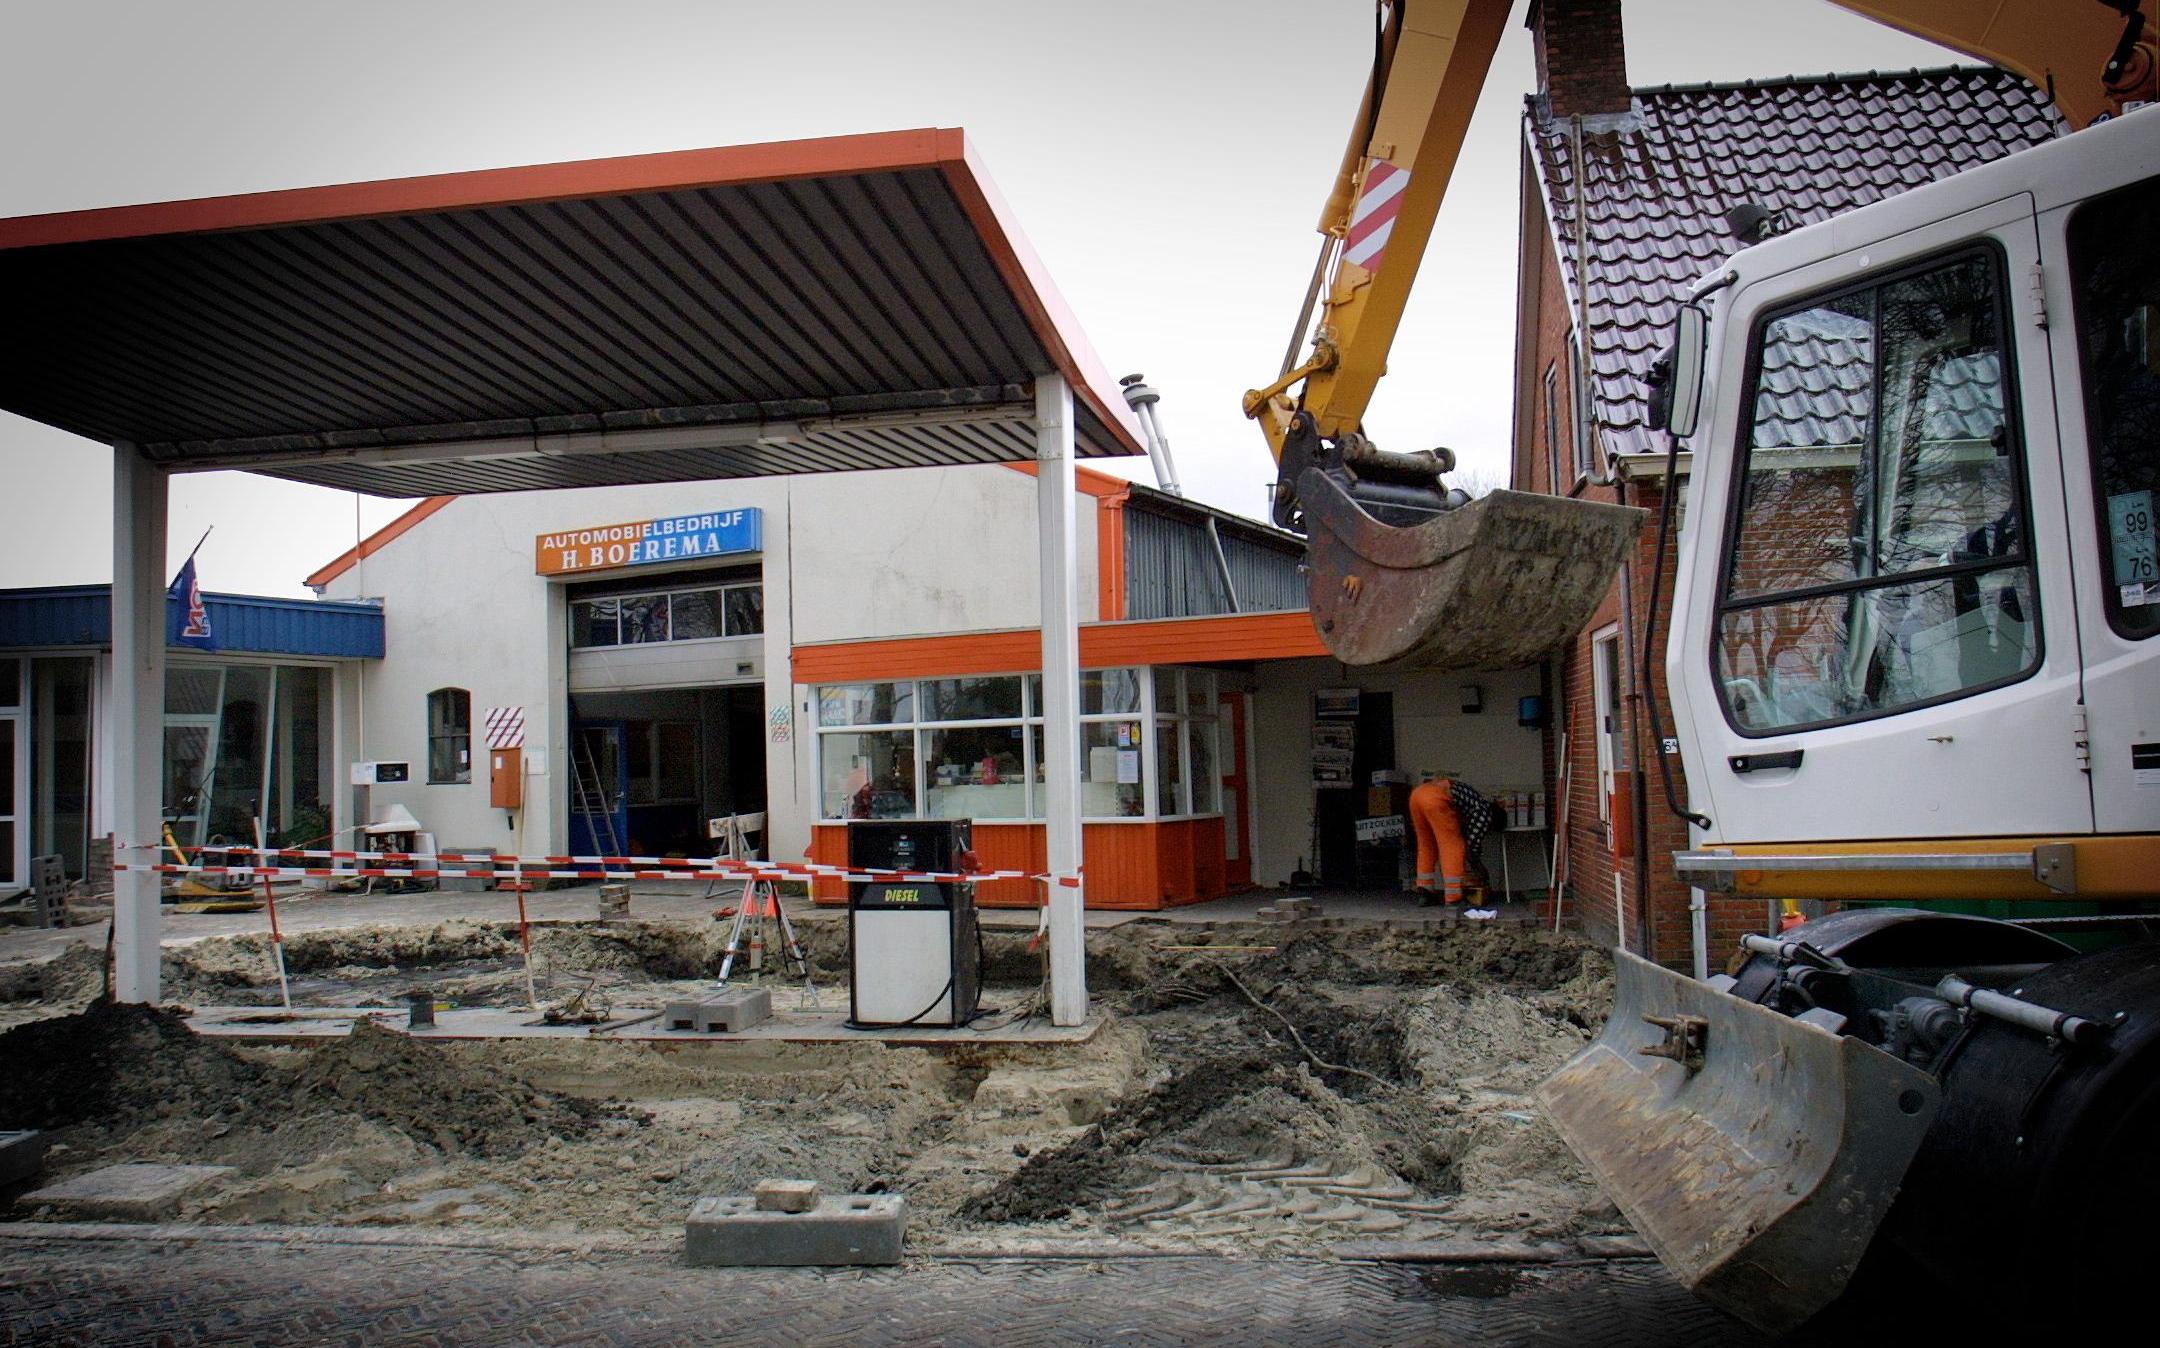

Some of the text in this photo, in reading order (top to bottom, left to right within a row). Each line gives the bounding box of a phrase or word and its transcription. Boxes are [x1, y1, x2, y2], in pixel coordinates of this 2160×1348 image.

[543, 511, 743, 549] AUTOMOBIELBEDRIJF
[2126, 511, 2148, 533] 99
[561, 532, 721, 569] H. BOEREMA
[2129, 557, 2152, 578] 76
[884, 888, 919, 902] DIESEL
